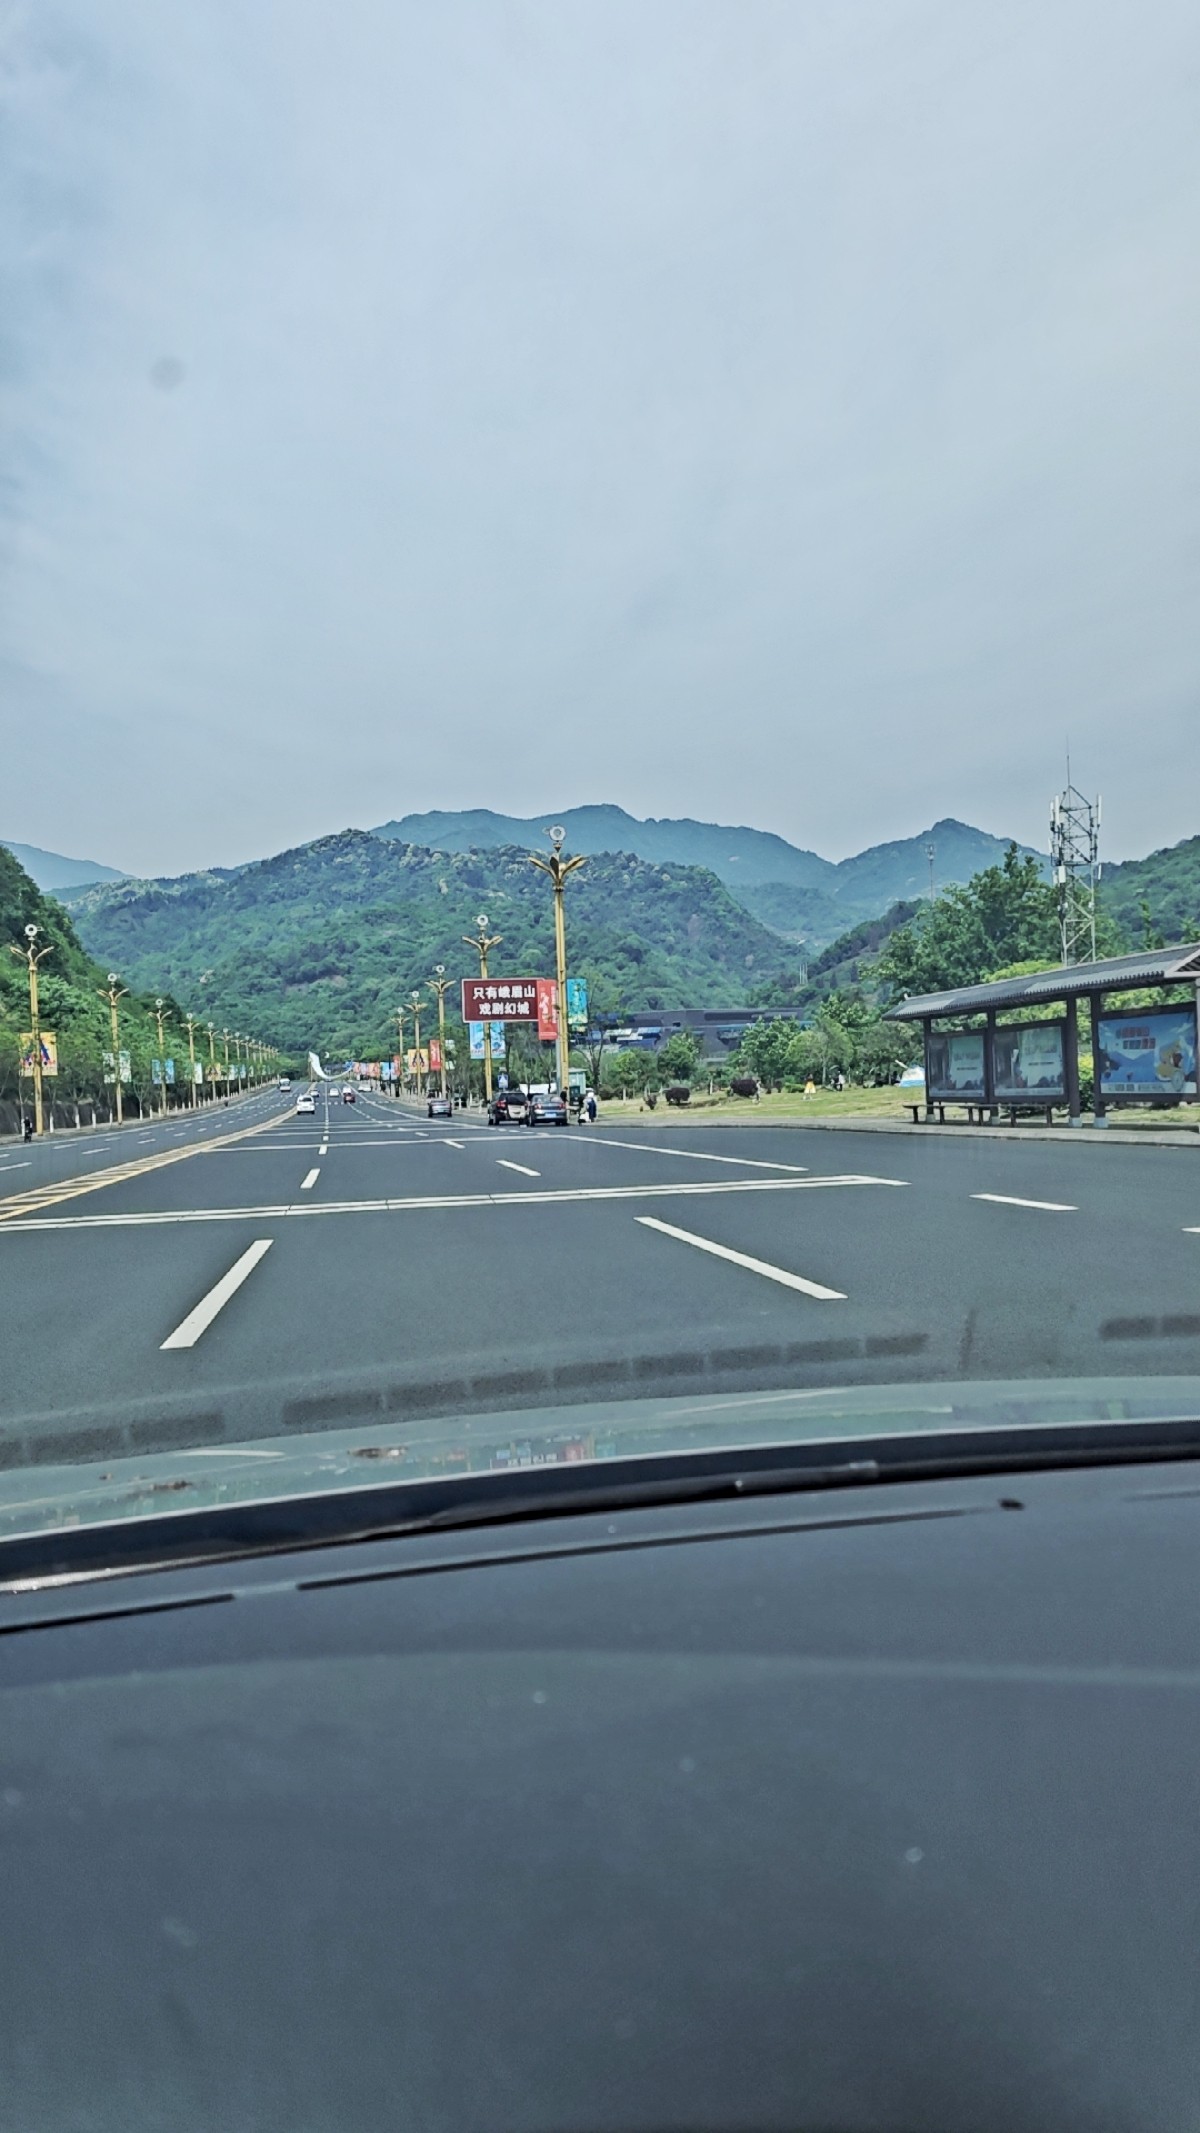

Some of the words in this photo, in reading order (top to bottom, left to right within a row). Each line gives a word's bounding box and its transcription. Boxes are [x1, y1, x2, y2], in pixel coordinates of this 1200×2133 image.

[472, 985, 536, 999] 只有峨眉山
[478, 1001, 530, 1015] 戏剧幻城
